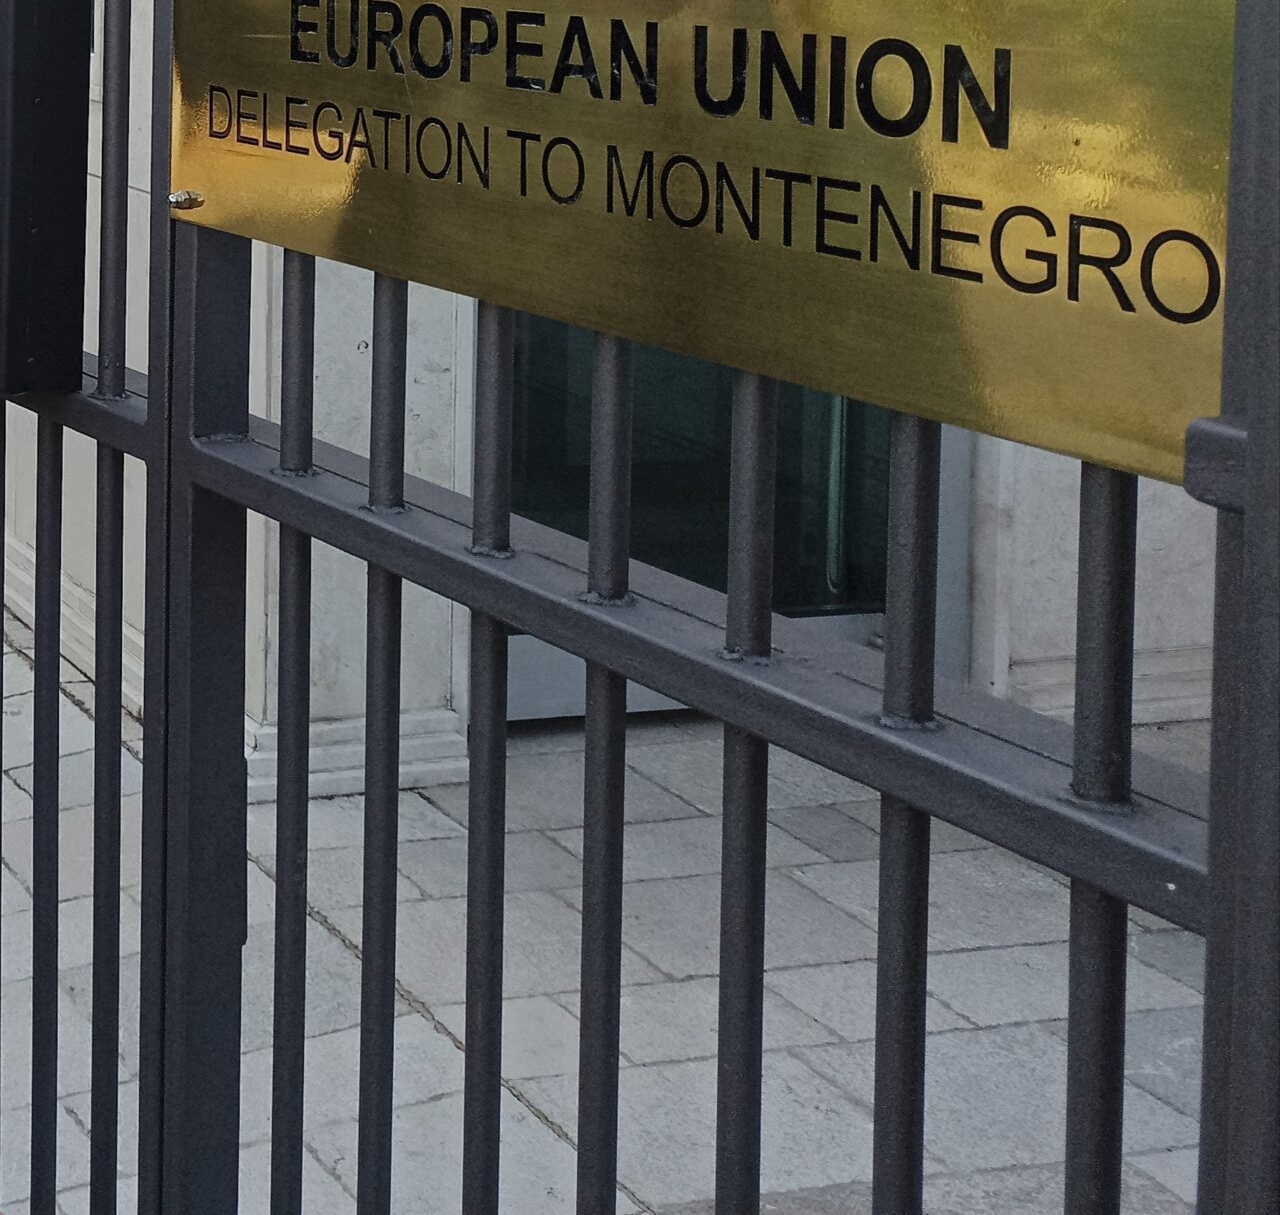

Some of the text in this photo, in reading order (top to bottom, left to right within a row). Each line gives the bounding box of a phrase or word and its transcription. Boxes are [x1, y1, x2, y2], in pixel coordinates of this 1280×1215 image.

[695, 25, 1012, 149] UNION
[207, 84, 1222, 323] DELEGATION TO MONTENEGRO
